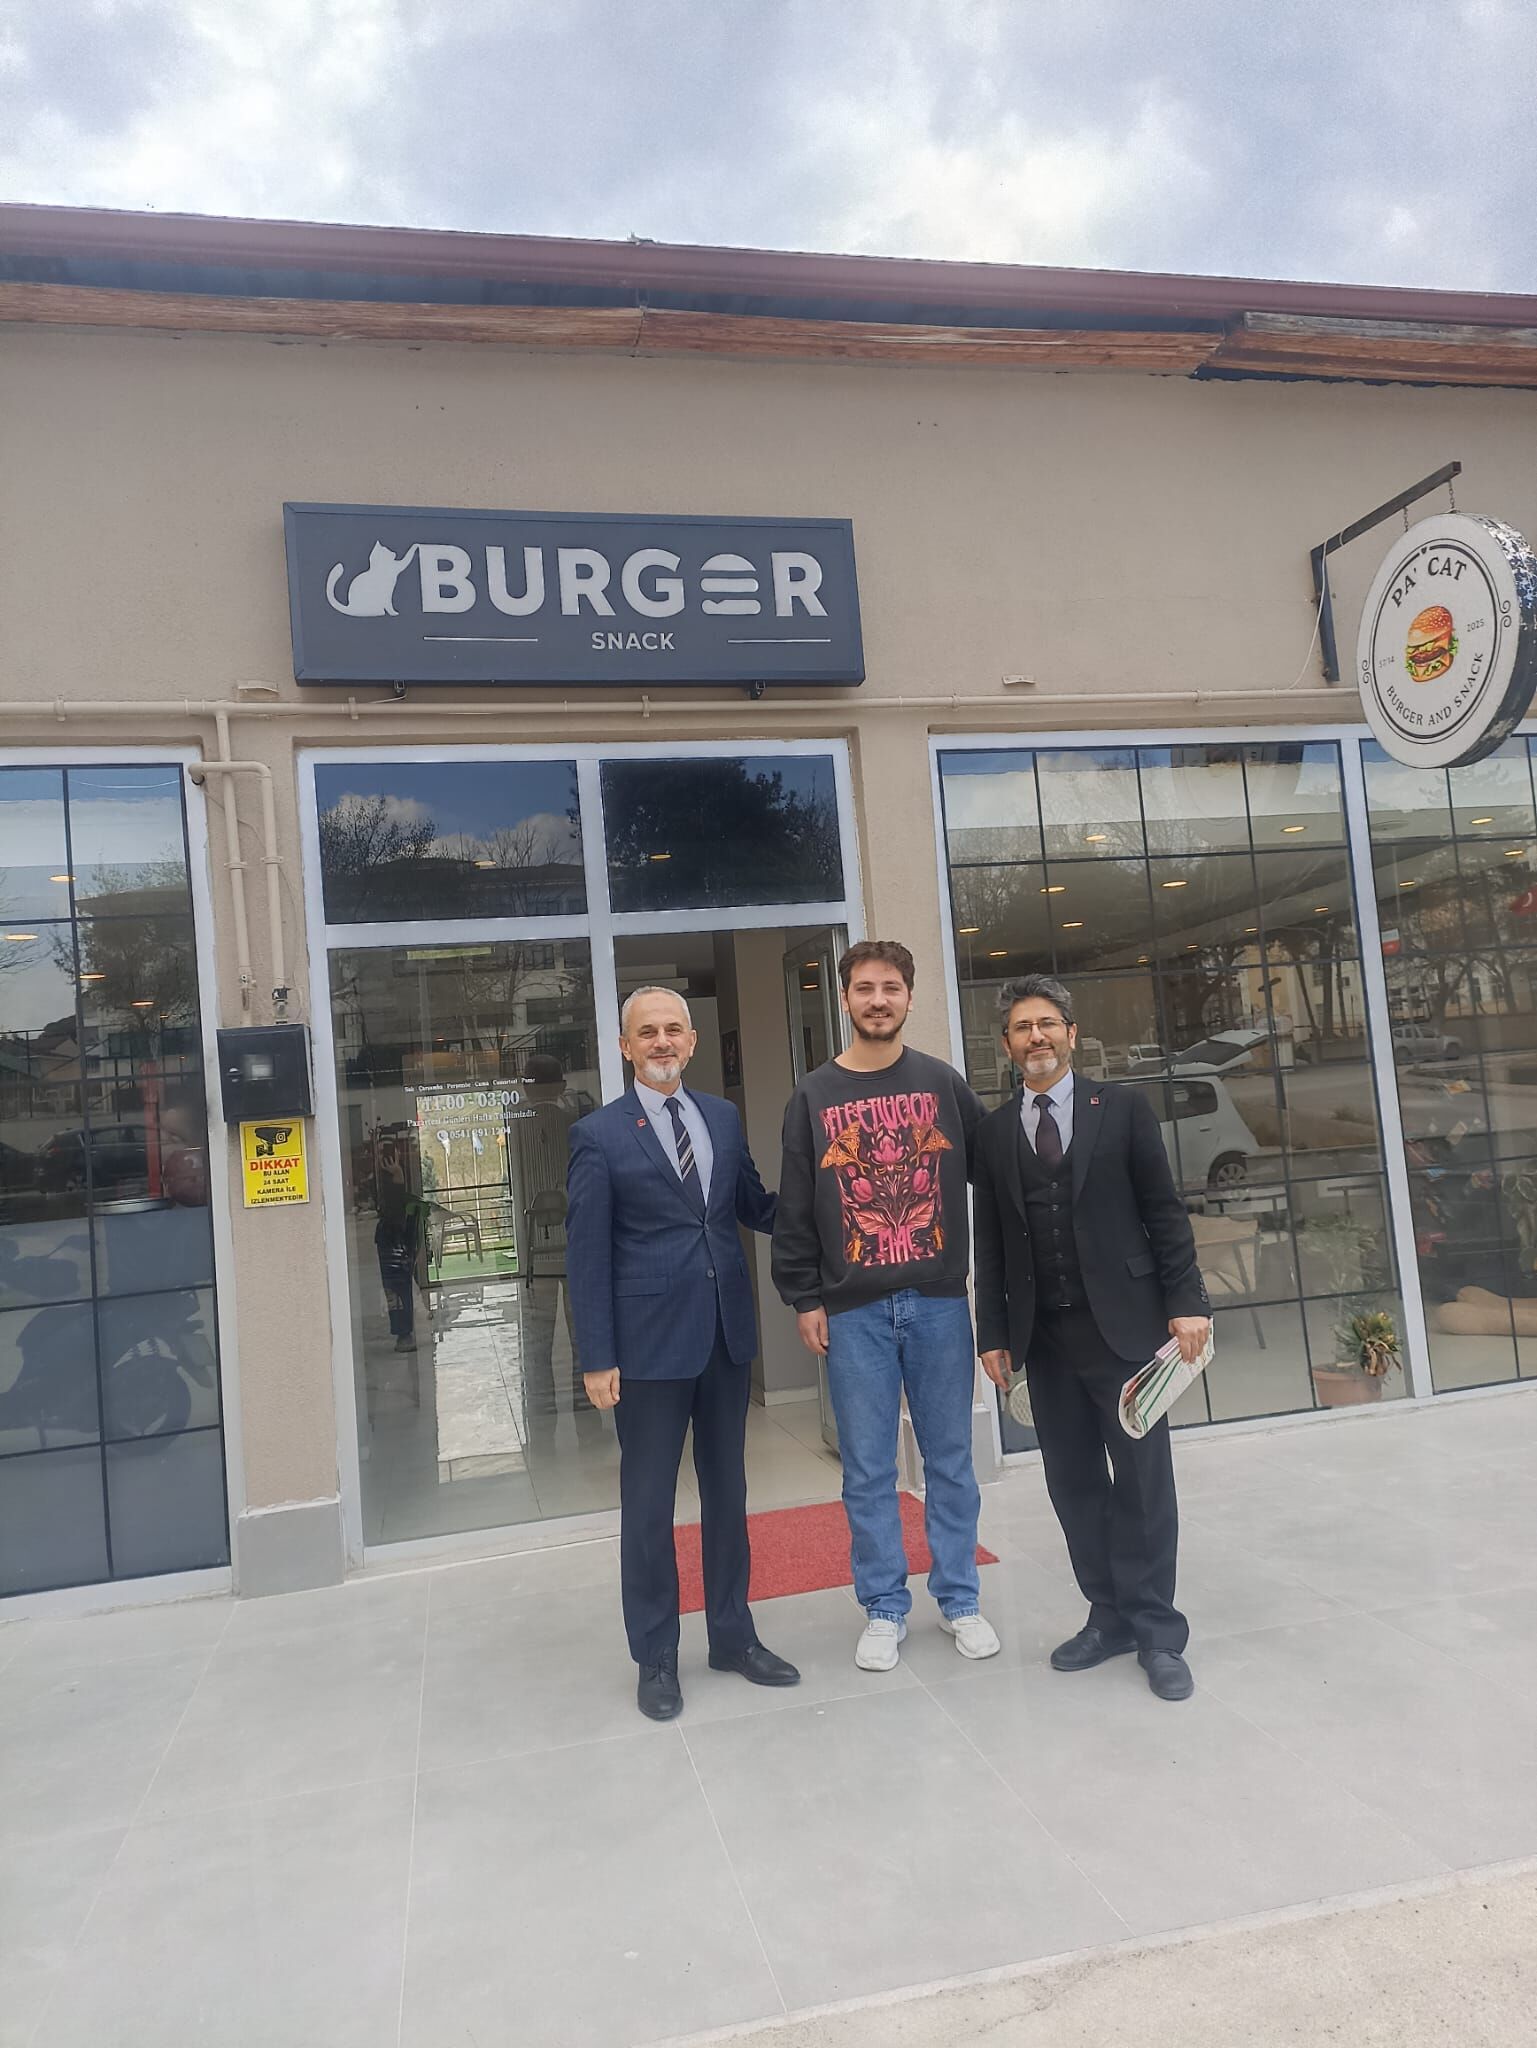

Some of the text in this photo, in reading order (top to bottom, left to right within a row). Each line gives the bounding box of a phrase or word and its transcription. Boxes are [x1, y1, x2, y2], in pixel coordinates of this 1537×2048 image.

[418, 543, 829, 618] BURGER
[1427, 556, 1468, 582] CAT
[590, 631, 676, 651] SNACK
[1386, 651, 1485, 727] BURGER AND SNACK
[257, 1187, 285, 1195] KAMERA
[272, 1177, 289, 1185] SAAT
